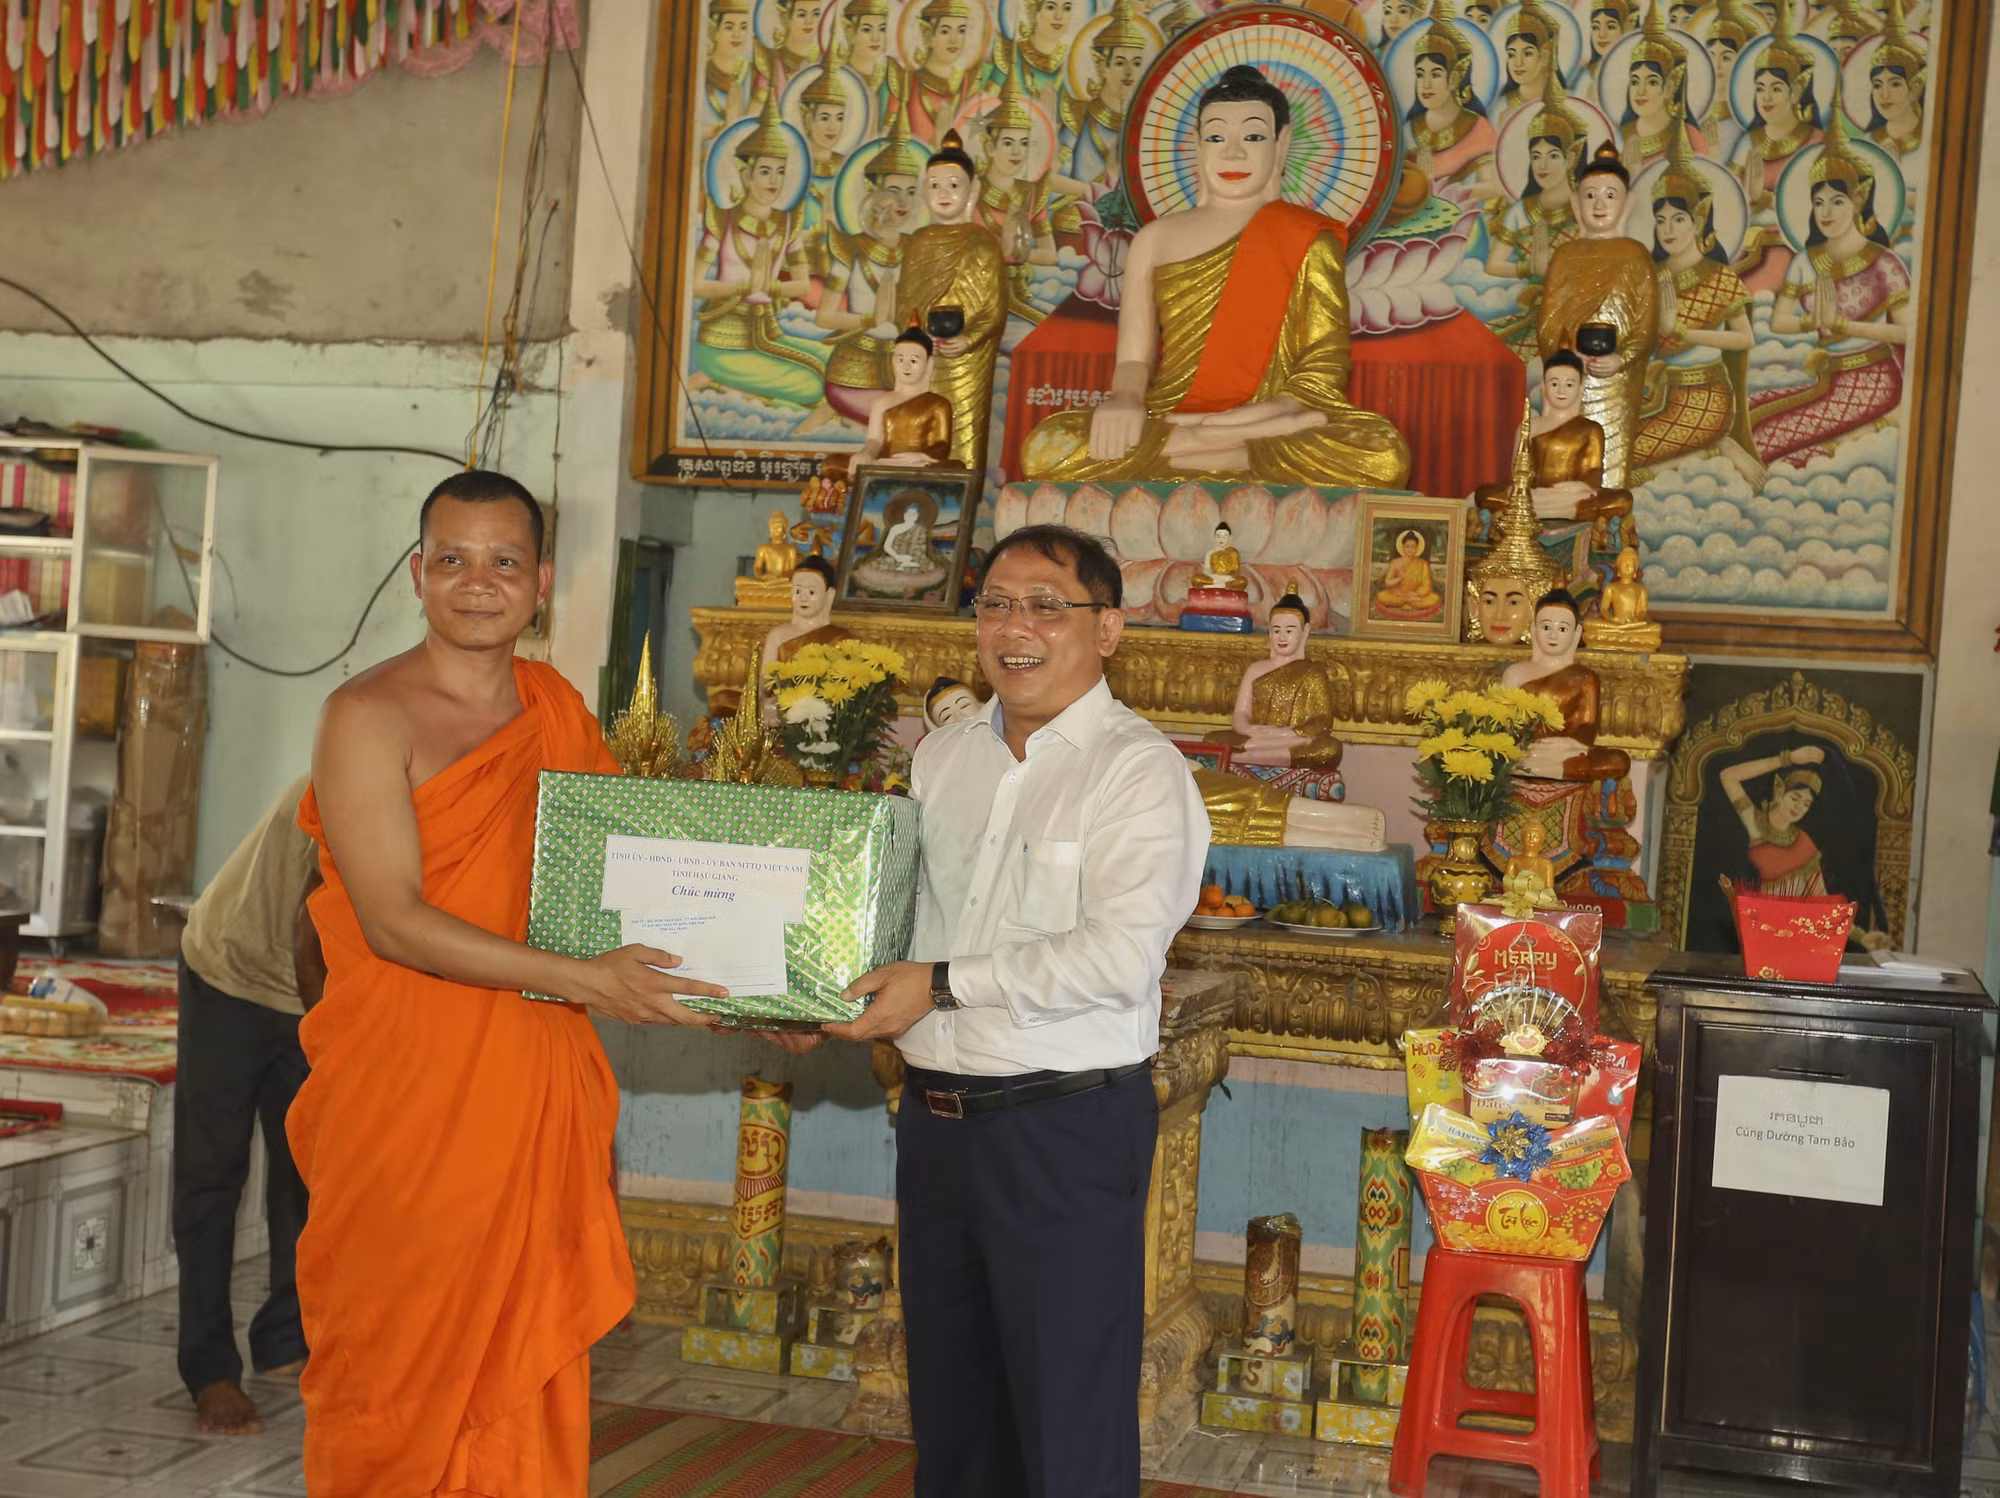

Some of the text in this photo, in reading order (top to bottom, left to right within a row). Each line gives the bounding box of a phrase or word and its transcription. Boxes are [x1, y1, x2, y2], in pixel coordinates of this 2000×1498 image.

[611, 851, 630, 860] TỈNH
[678, 857, 700, 865] UBND
[719, 860, 736, 868] BAN
[737, 862, 762, 871] MTTQ
[762, 863, 783, 873] VIỆT
[672, 869, 738, 882] TỈNH HẬU GIANG
[671, 884, 736, 902] Chúc mừng
[1494, 949, 1558, 971] MERRY
[1411, 1043, 1446, 1056] HURA
[1476, 1098, 1513, 1109] Dates
[1735, 1126, 1856, 1149] Cúng Dường Tam Bảo
